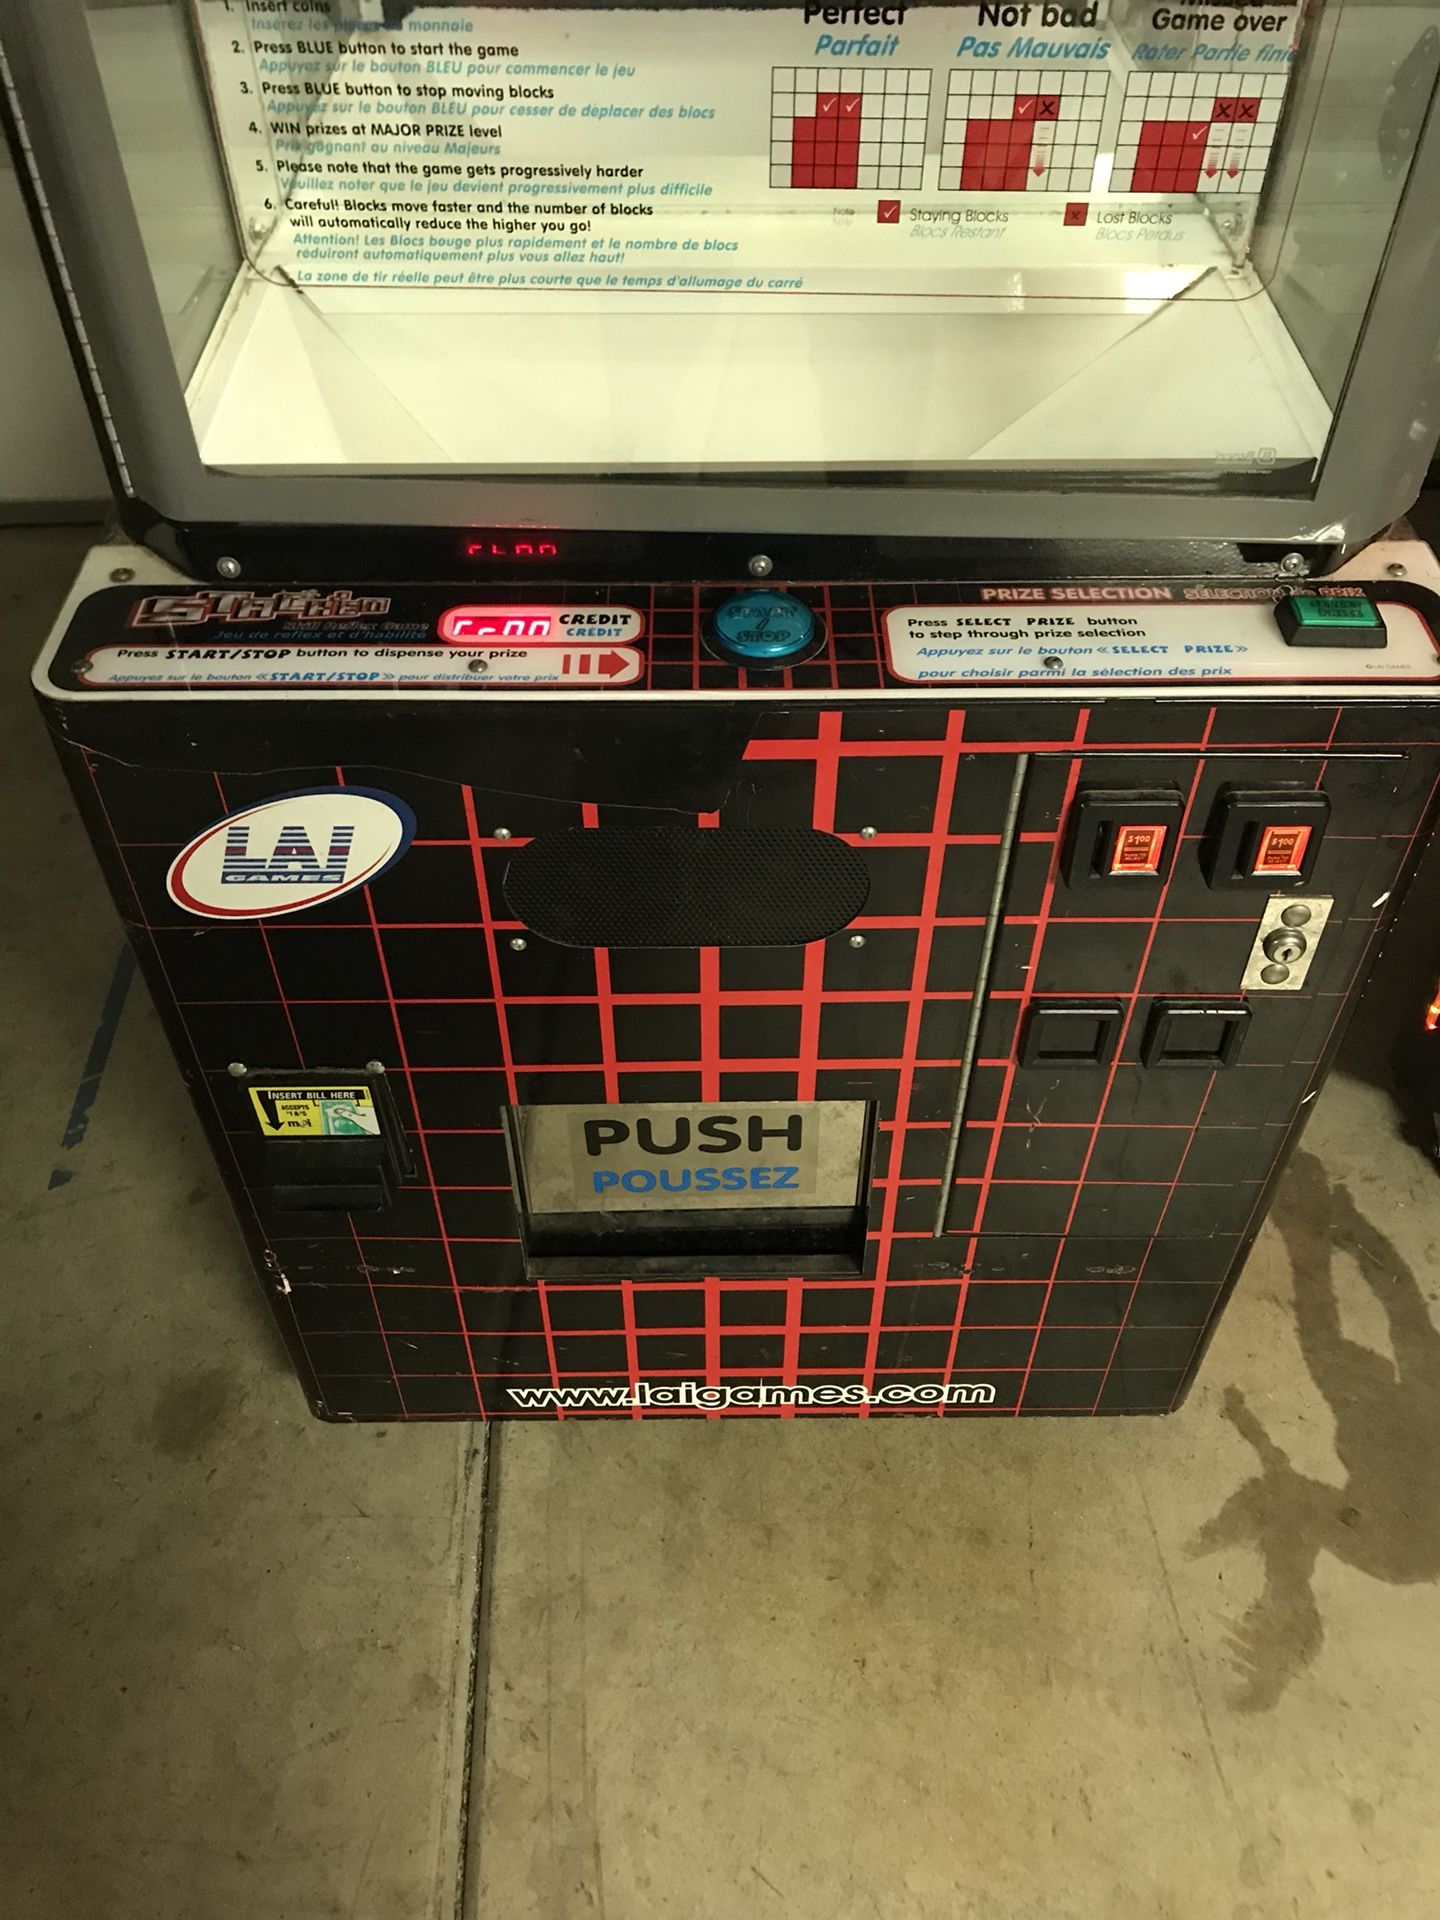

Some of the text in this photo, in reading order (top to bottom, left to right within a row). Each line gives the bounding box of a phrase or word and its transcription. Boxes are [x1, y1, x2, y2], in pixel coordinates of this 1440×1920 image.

[978, 0, 1099, 28] Not bad
[1152, 8, 1288, 32] Game over
[409, 19, 473, 32] monnaie
[231, 40, 519, 60] 2. Press BLUE button to start the game
[815, 34, 900, 56] Parfait
[957, 36, 1111, 59] Pas Mauvais
[1132, 43, 1187, 61] Rater
[1193, 42, 1249, 62] Partie
[259, 59, 636, 80] Appuyez sur le bouton BLEU pour commencer le jeu
[240, 82, 554, 102] 3. Press BLUE button to stop moving blocks
[249, 121, 502, 138] 4. WIN prizes at MAJOR PRIZE level
[256, 160, 644, 180] 5. Please note that the game gets progressively harder
[264, 198, 654, 216] 6. Careful! Blocks move faster and the number of blocks
[290, 215, 592, 234] will automatically reduce the higher you go!
[910, 208, 1009, 225] Staying Blocks
[1096, 211, 1173, 224] Lost Blocks
[363, 248, 484, 263] automatiquement
[488, 251, 514, 265] plus
[519, 252, 550, 264] vous
[554, 251, 585, 264] allez
[589, 251, 626, 264] haut!
[298, 270, 804, 290] La zone de tir réelle peut être plus courte que le temps d'allumage du carré
[981, 586, 1173, 600] PRIZE SELECTION
[558, 613, 632, 626] CREDIT
[908, 617, 1138, 628] Press SELECT PRIZE button
[736, 630, 791, 643] STOP
[909, 628, 1147, 642] to step through prize selection
[117, 648, 528, 660] Press START/STOP button to dispense your prize
[916, 647, 984, 658] Appuyez
[988, 648, 1014, 656] sur
[1018, 646, 1033, 656] le
[1037, 646, 1093, 656] bouton
[918, 666, 1233, 680] pour choisir parmi la sélection des prix
[223, 826, 355, 869] LAI
[225, 874, 343, 882] GAMES
[268, 1090, 303, 1100] INSERT
[306, 1092, 327, 1100] BILL
[583, 1114, 803, 1157] PUSH
[593, 1166, 800, 1194] POUSSEZ
[505, 1382, 998, 1411] www.laigames.com
